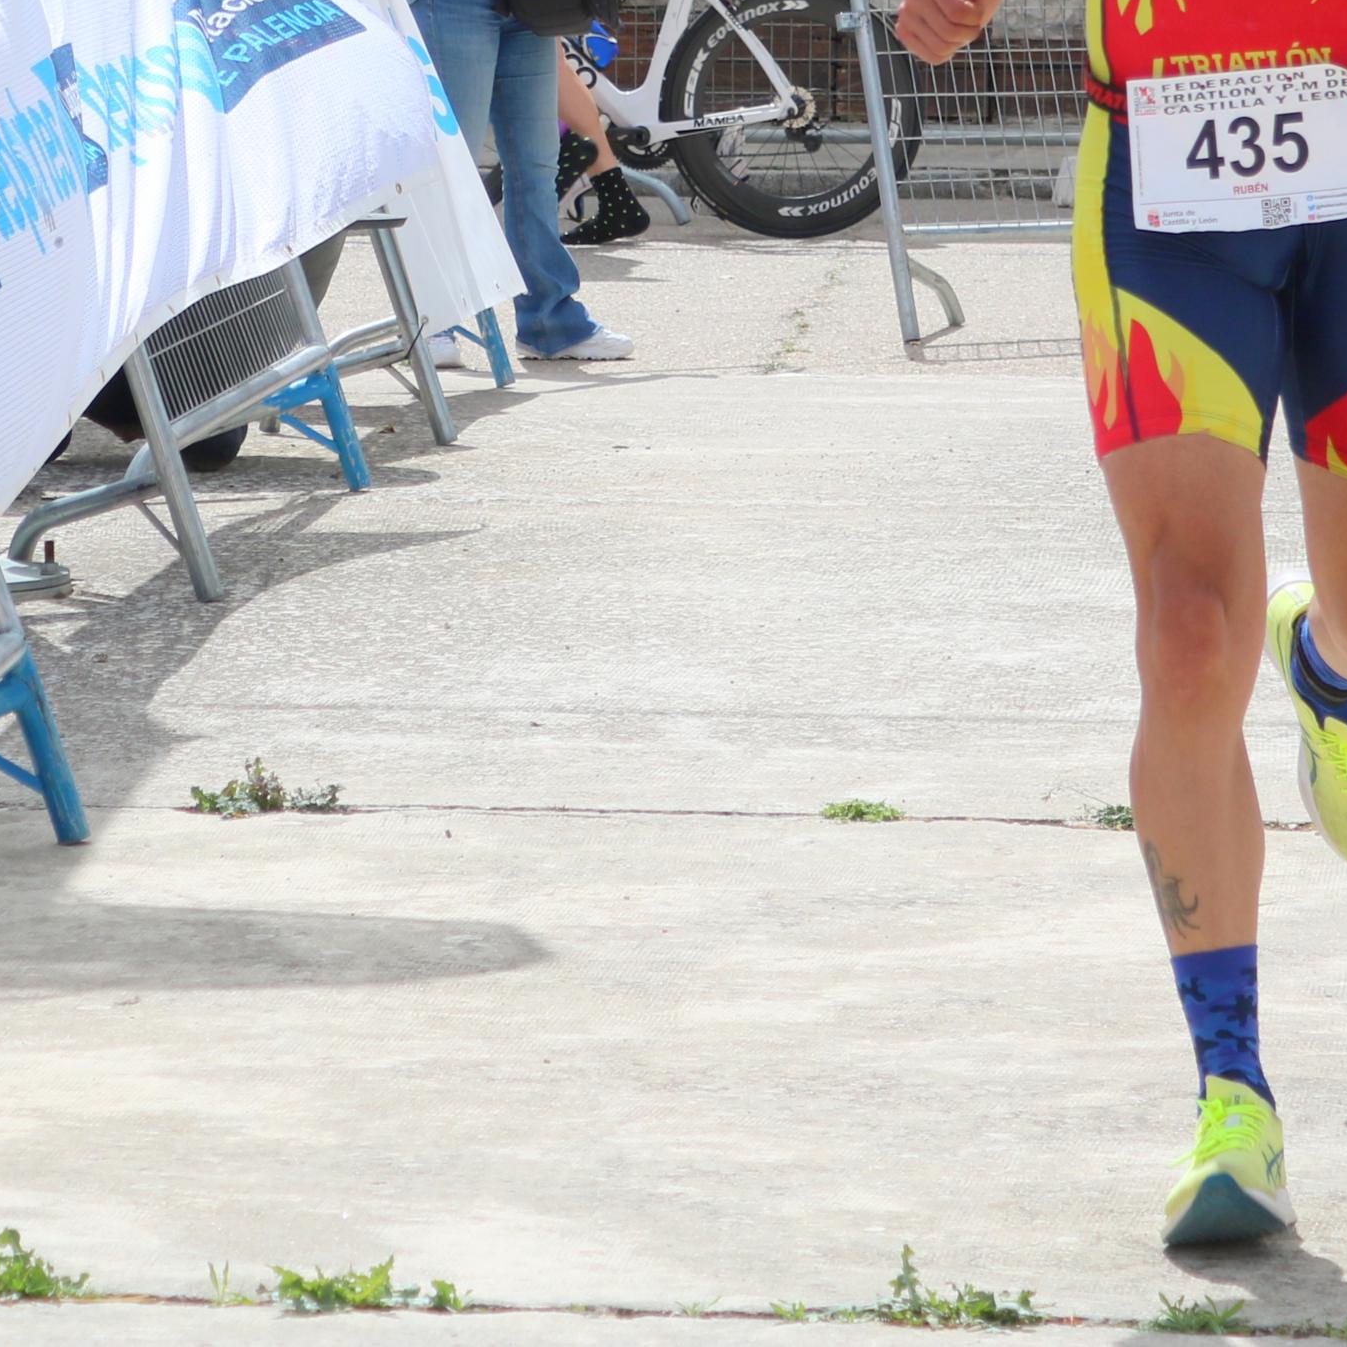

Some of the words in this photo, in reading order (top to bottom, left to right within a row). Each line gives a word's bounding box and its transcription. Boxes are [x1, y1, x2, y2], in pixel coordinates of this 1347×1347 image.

[1161, 71, 1304, 93] FEDERACION
[1162, 85, 1256, 103] TRIATLON
[1264, 85, 1274, 95] Y
[1163, 98, 1265, 116] CASTILLA
[1276, 95, 1287, 105] Y
[1185, 111, 1310, 181] 435
[1233, 183, 1269, 196] RUBÉN
